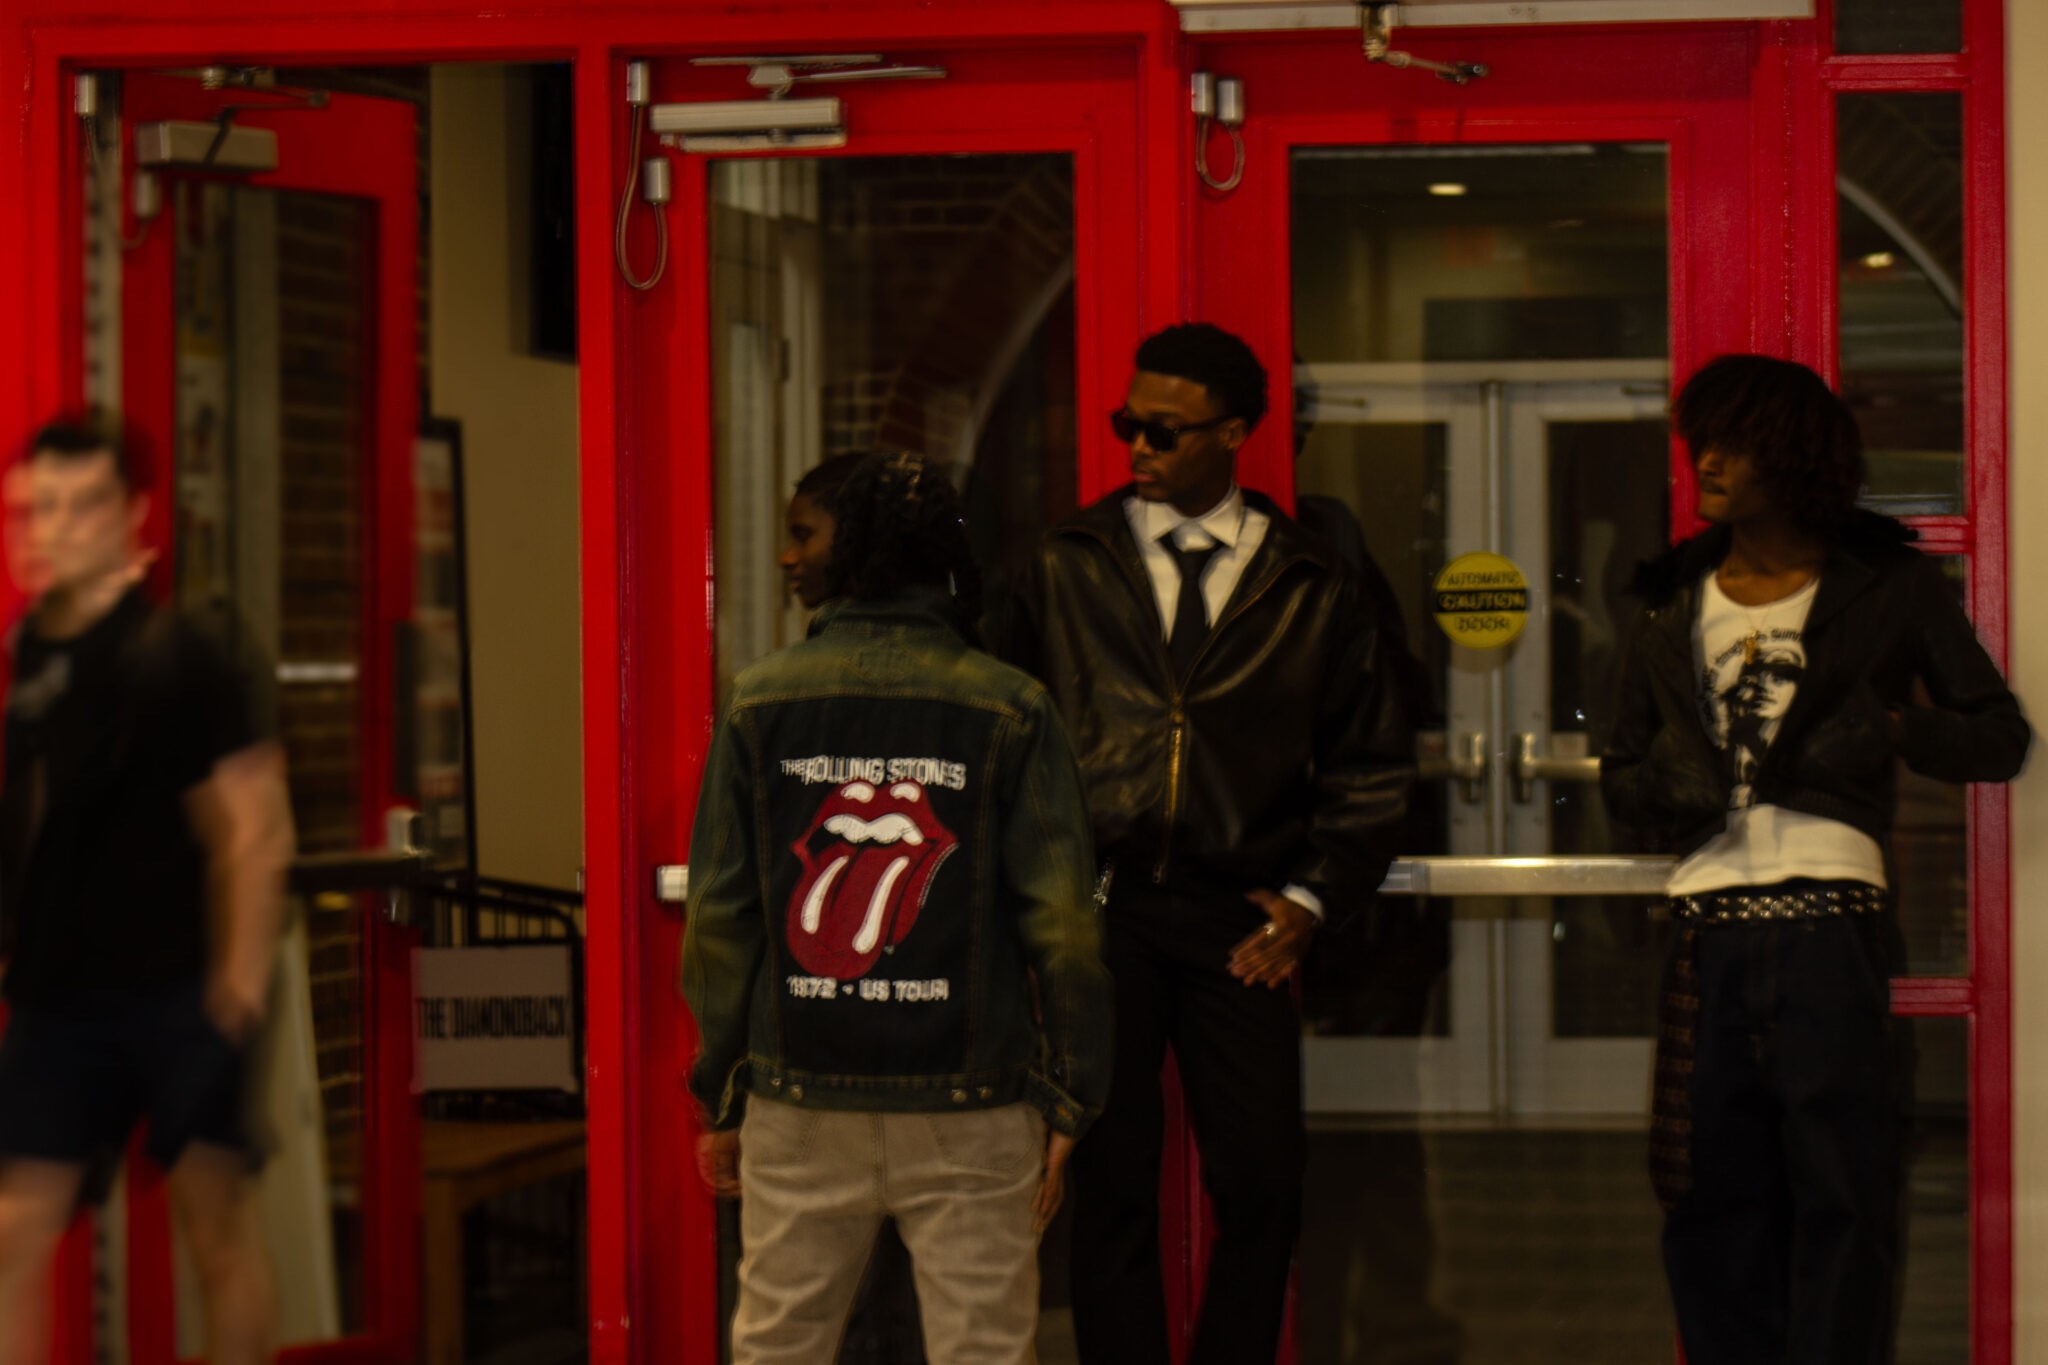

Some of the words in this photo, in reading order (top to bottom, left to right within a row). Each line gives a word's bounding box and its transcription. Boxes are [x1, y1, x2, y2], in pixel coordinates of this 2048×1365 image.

[1438, 591, 1526, 609] CAUTION
[780, 759, 806, 777] THE
[801, 755, 886, 785] ROLLING
[887, 757, 967, 791] STONES
[786, 975, 838, 1000] 1972
[858, 979, 890, 1002] US
[892, 978, 950, 1002] TOUR
[415, 996, 446, 1038] THE
[452, 995, 565, 1038] DIAMONDBACK
